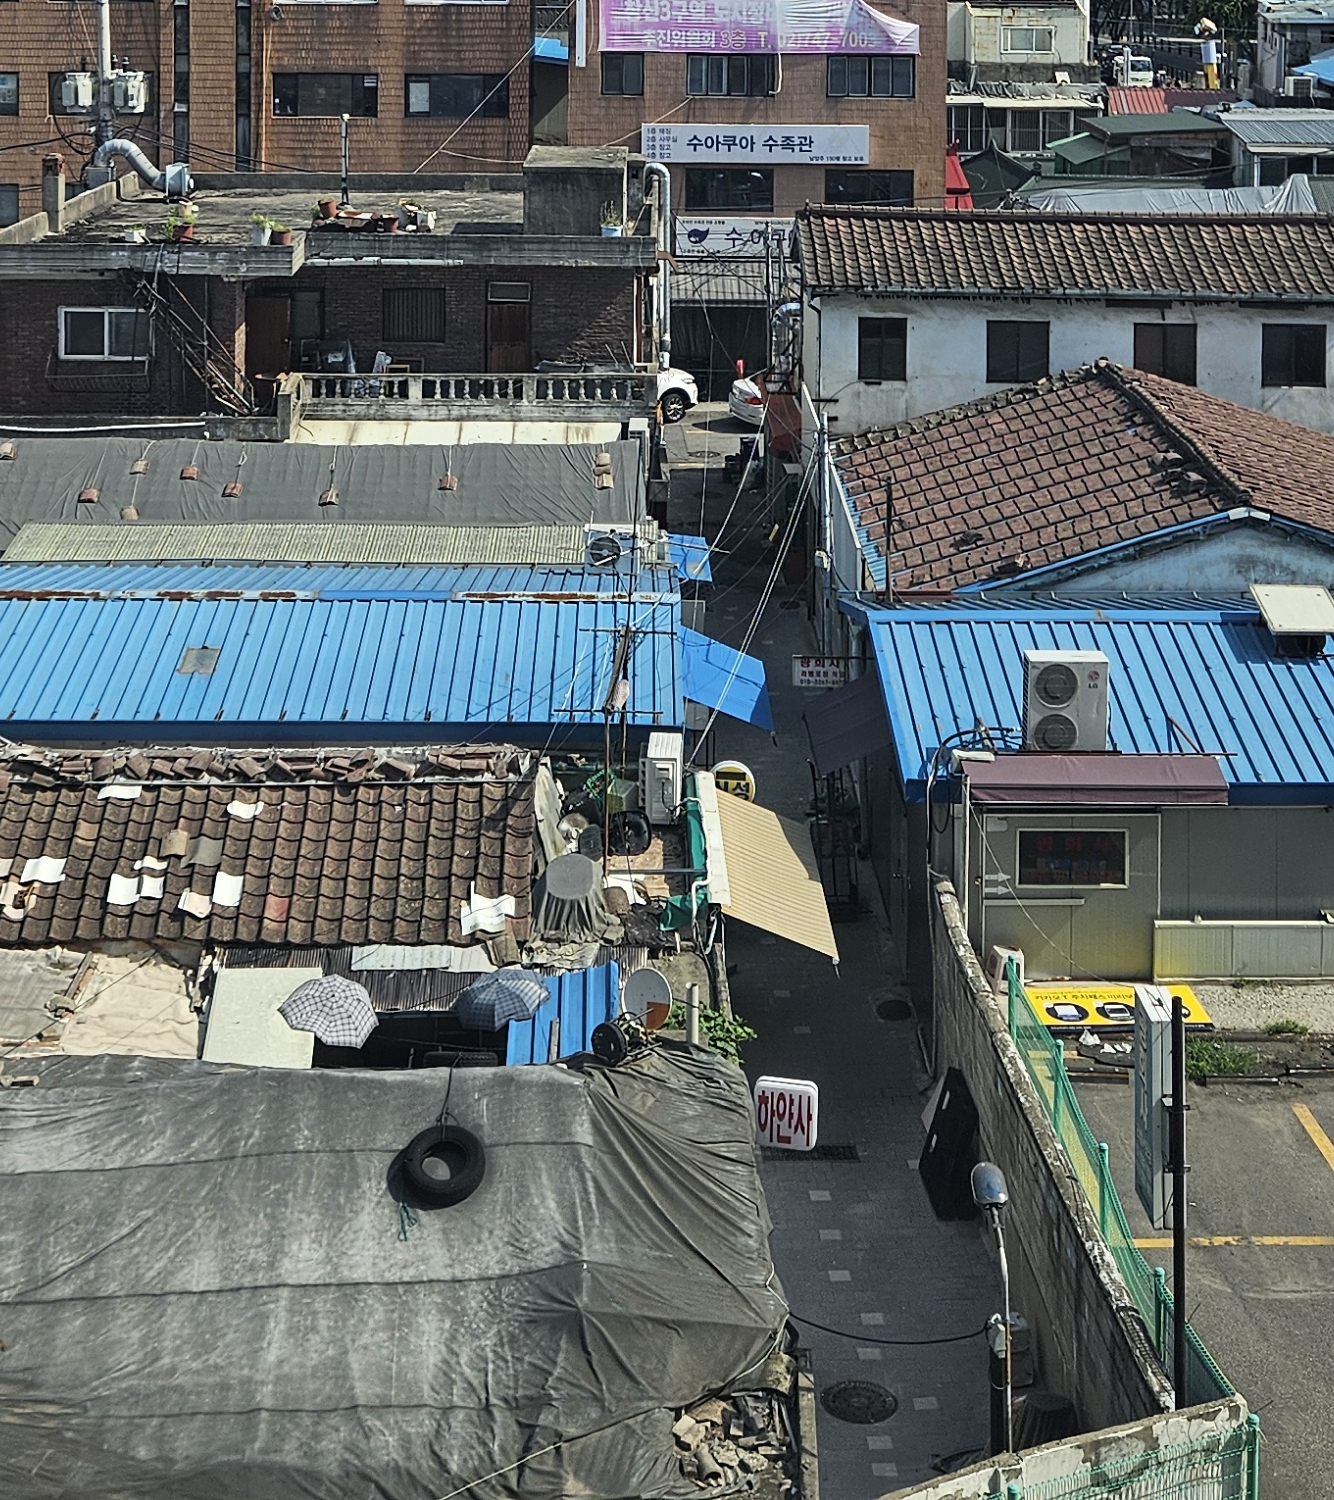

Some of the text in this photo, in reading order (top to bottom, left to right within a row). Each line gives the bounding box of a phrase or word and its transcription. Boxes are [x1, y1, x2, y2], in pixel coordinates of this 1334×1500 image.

[720, 31, 745, 48] 3층
[686, 134, 814, 153] 수아쿠아 수족관
[758, 1089, 813, 1147] 하얀사
